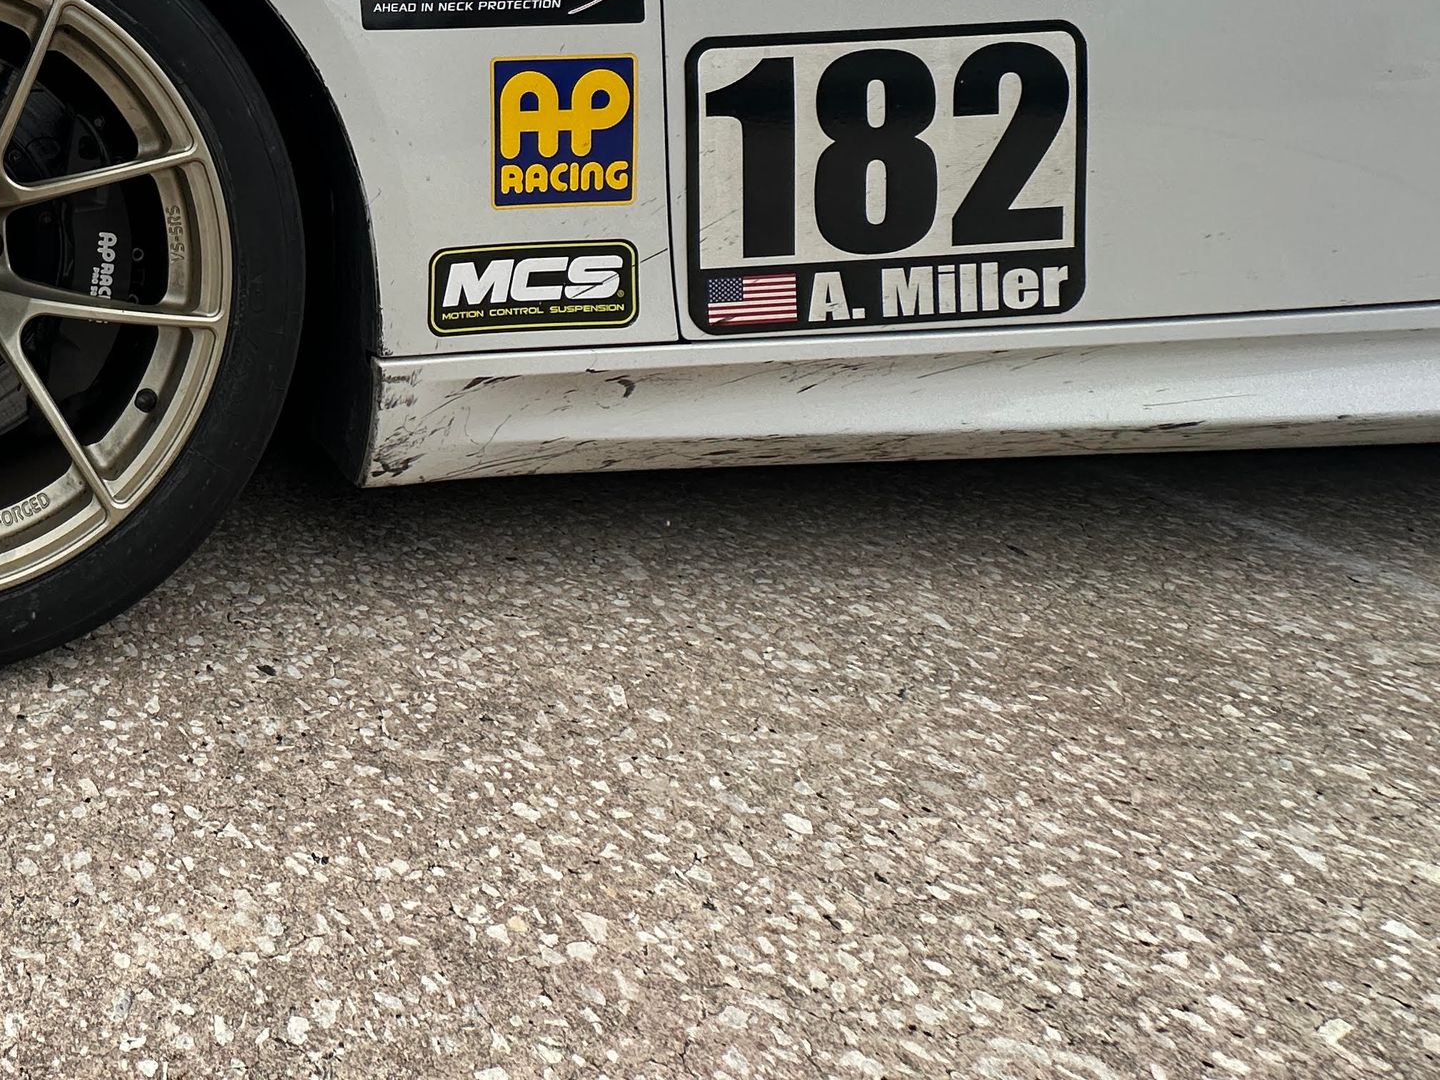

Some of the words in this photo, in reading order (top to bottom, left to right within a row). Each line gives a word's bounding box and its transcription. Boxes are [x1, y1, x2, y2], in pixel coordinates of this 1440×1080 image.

[373, 3, 417, 13] AHEAD
[421, 2, 434, 12] IN
[438, 1, 473, 11] NECK
[478, 0, 561, 11] PROTECTION
[500, 69, 631, 159] AP
[705, 42, 1070, 258] 182
[500, 161, 629, 194] RACING
[442, 255, 624, 308] MCS
[808, 271, 866, 322] A.
[881, 262, 1069, 318] Miller
[442, 310, 484, 320] MOTION
[489, 307, 544, 316] CONTROL
[550, 303, 625, 313] SUSPENSION
